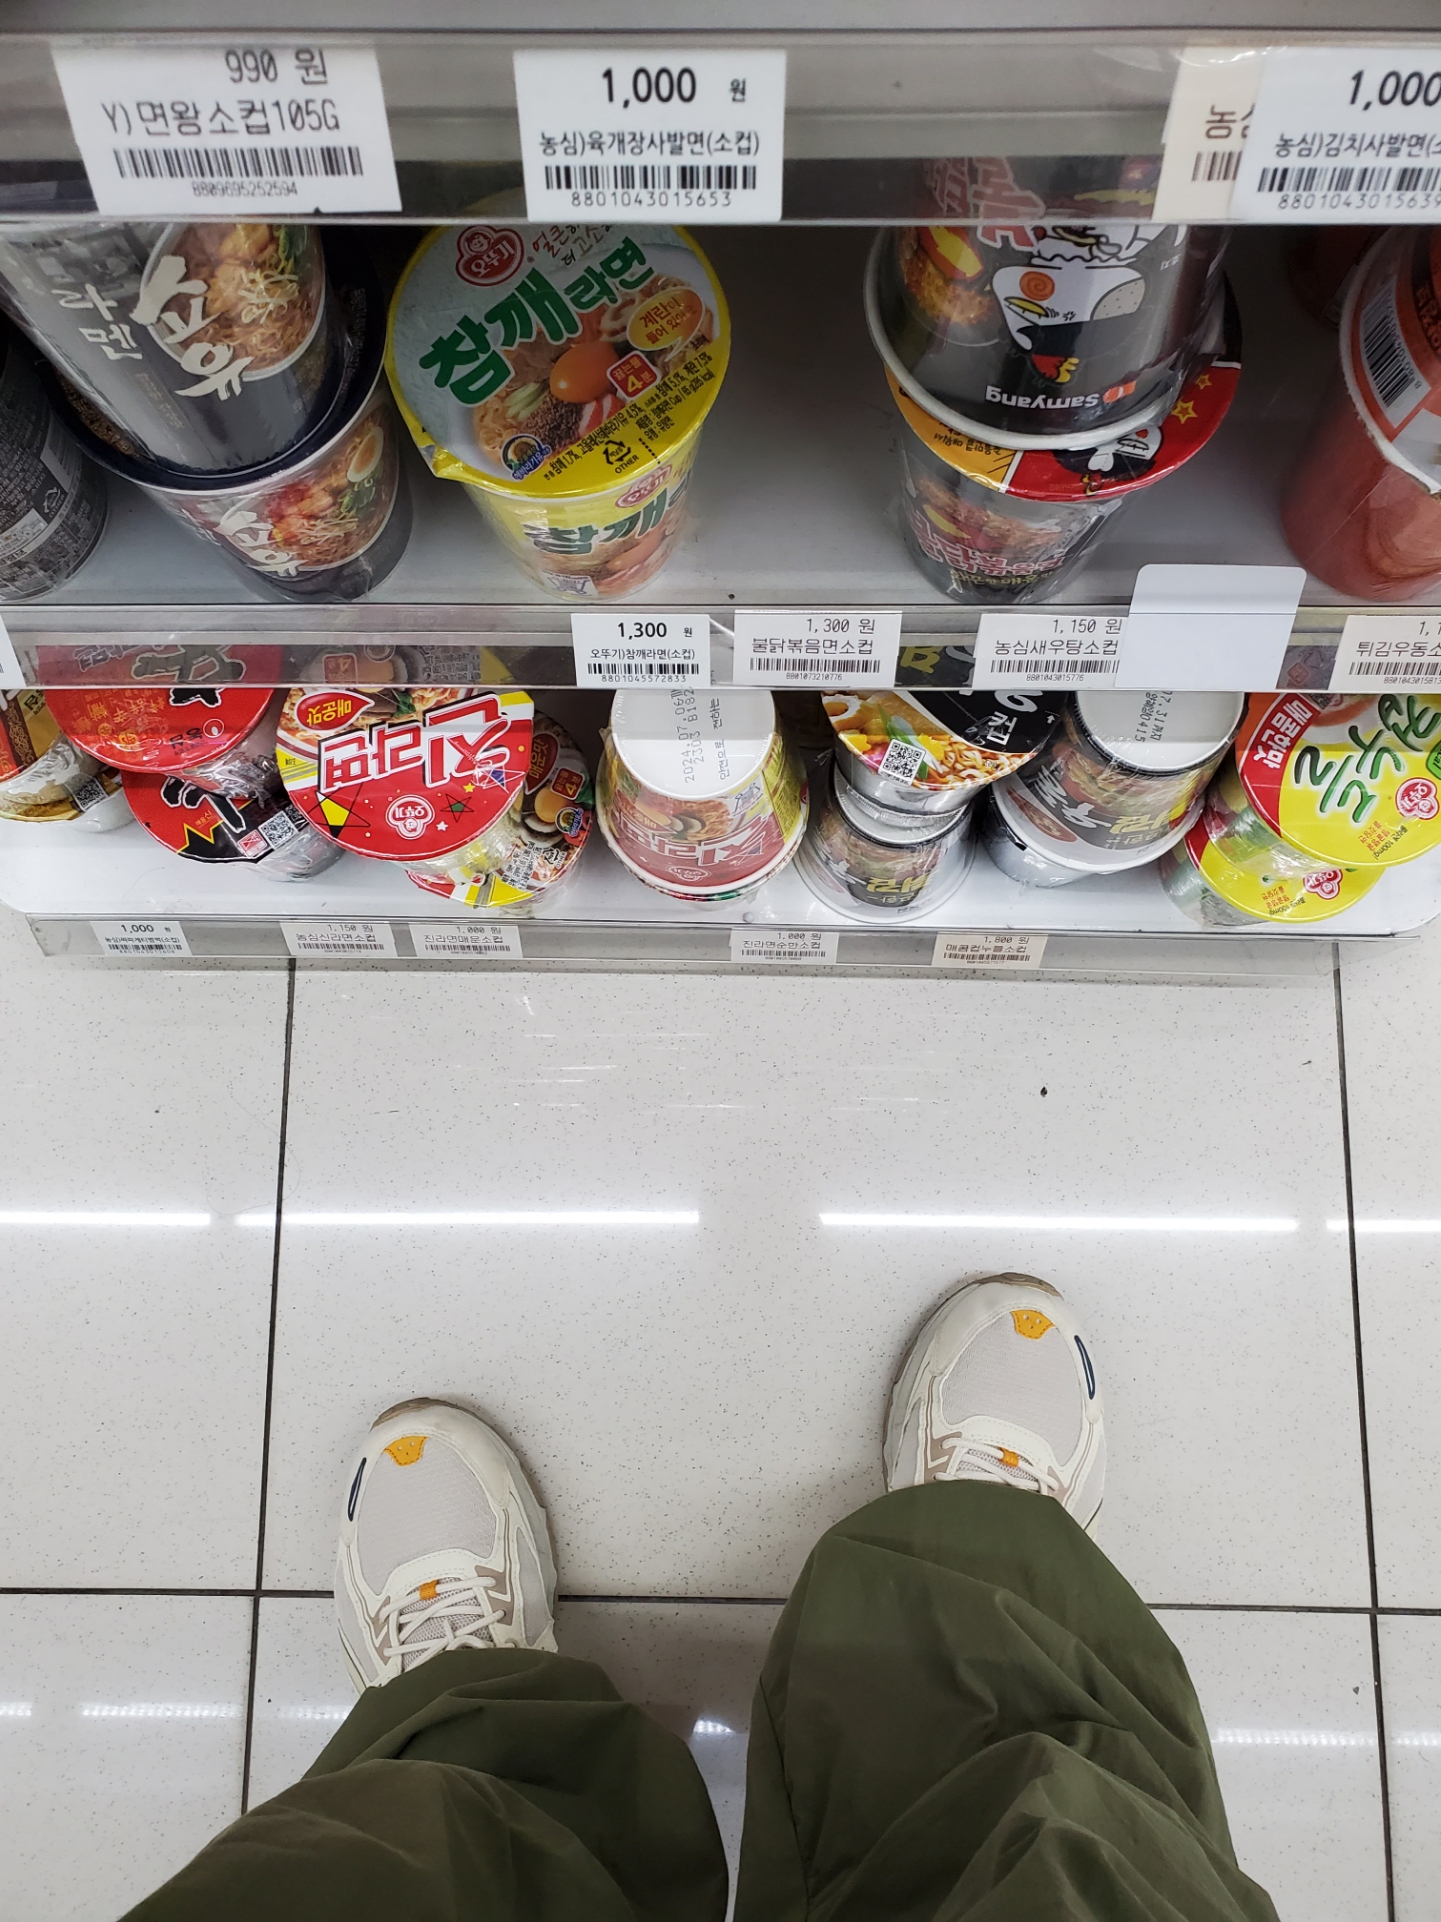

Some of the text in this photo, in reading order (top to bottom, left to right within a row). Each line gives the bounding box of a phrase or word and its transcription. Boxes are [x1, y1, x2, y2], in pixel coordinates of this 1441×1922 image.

[225, 48, 329, 86] 990 원
[602, 66, 746, 109] 1,000 원
[1349, 69, 1441, 111] 1,000
[539, 130, 760, 157] 농심)육개장사발면(소컵)
[193, 181, 298, 198] 8809695252594
[571, 192, 732, 207] 8801043015653
[470, 241, 515, 278] 오뚜기
[419, 236, 654, 405] 참깨라면
[639, 296, 683, 327] 계란이
[645, 323, 669, 344] 들어
[627, 373, 643, 394] 4
[986, 385, 1099, 409] Samyang
[613, 453, 640, 474] OTHER
[617, 622, 693, 640] 1,300 원
[806, 618, 876, 635] 1,300 원
[1052, 619, 1122, 635] 1,150 원
[590, 648, 695, 661] 오뚜기)참깨라면(소컵)
[751, 637, 874, 655] 불닭볶음면소컵
[994, 639, 1118, 657] 농심새우탕소컵
[601, 675, 687, 683] 8801045572833
[786, 672, 843, 681] 8801073210776
[1026, 673, 1084, 683] 8801043015776
[307, 699, 352, 727] 매운맛
[319, 692, 511, 793] 진라면
[709, 698, 730, 780] 안전으로 전하는
[1254, 700, 1313, 769] 매콤한맛
[528, 737, 549, 779] 매운맛
[565, 783, 576, 796] 4
[395, 806, 425, 818] 오뚜기
[121, 925, 154, 933] 1,000
[296, 934, 376, 942] 농심신라면소컵
[424, 935, 503, 943] 진라면매운소컵
[743, 940, 820, 949] 진라면순한소컵
